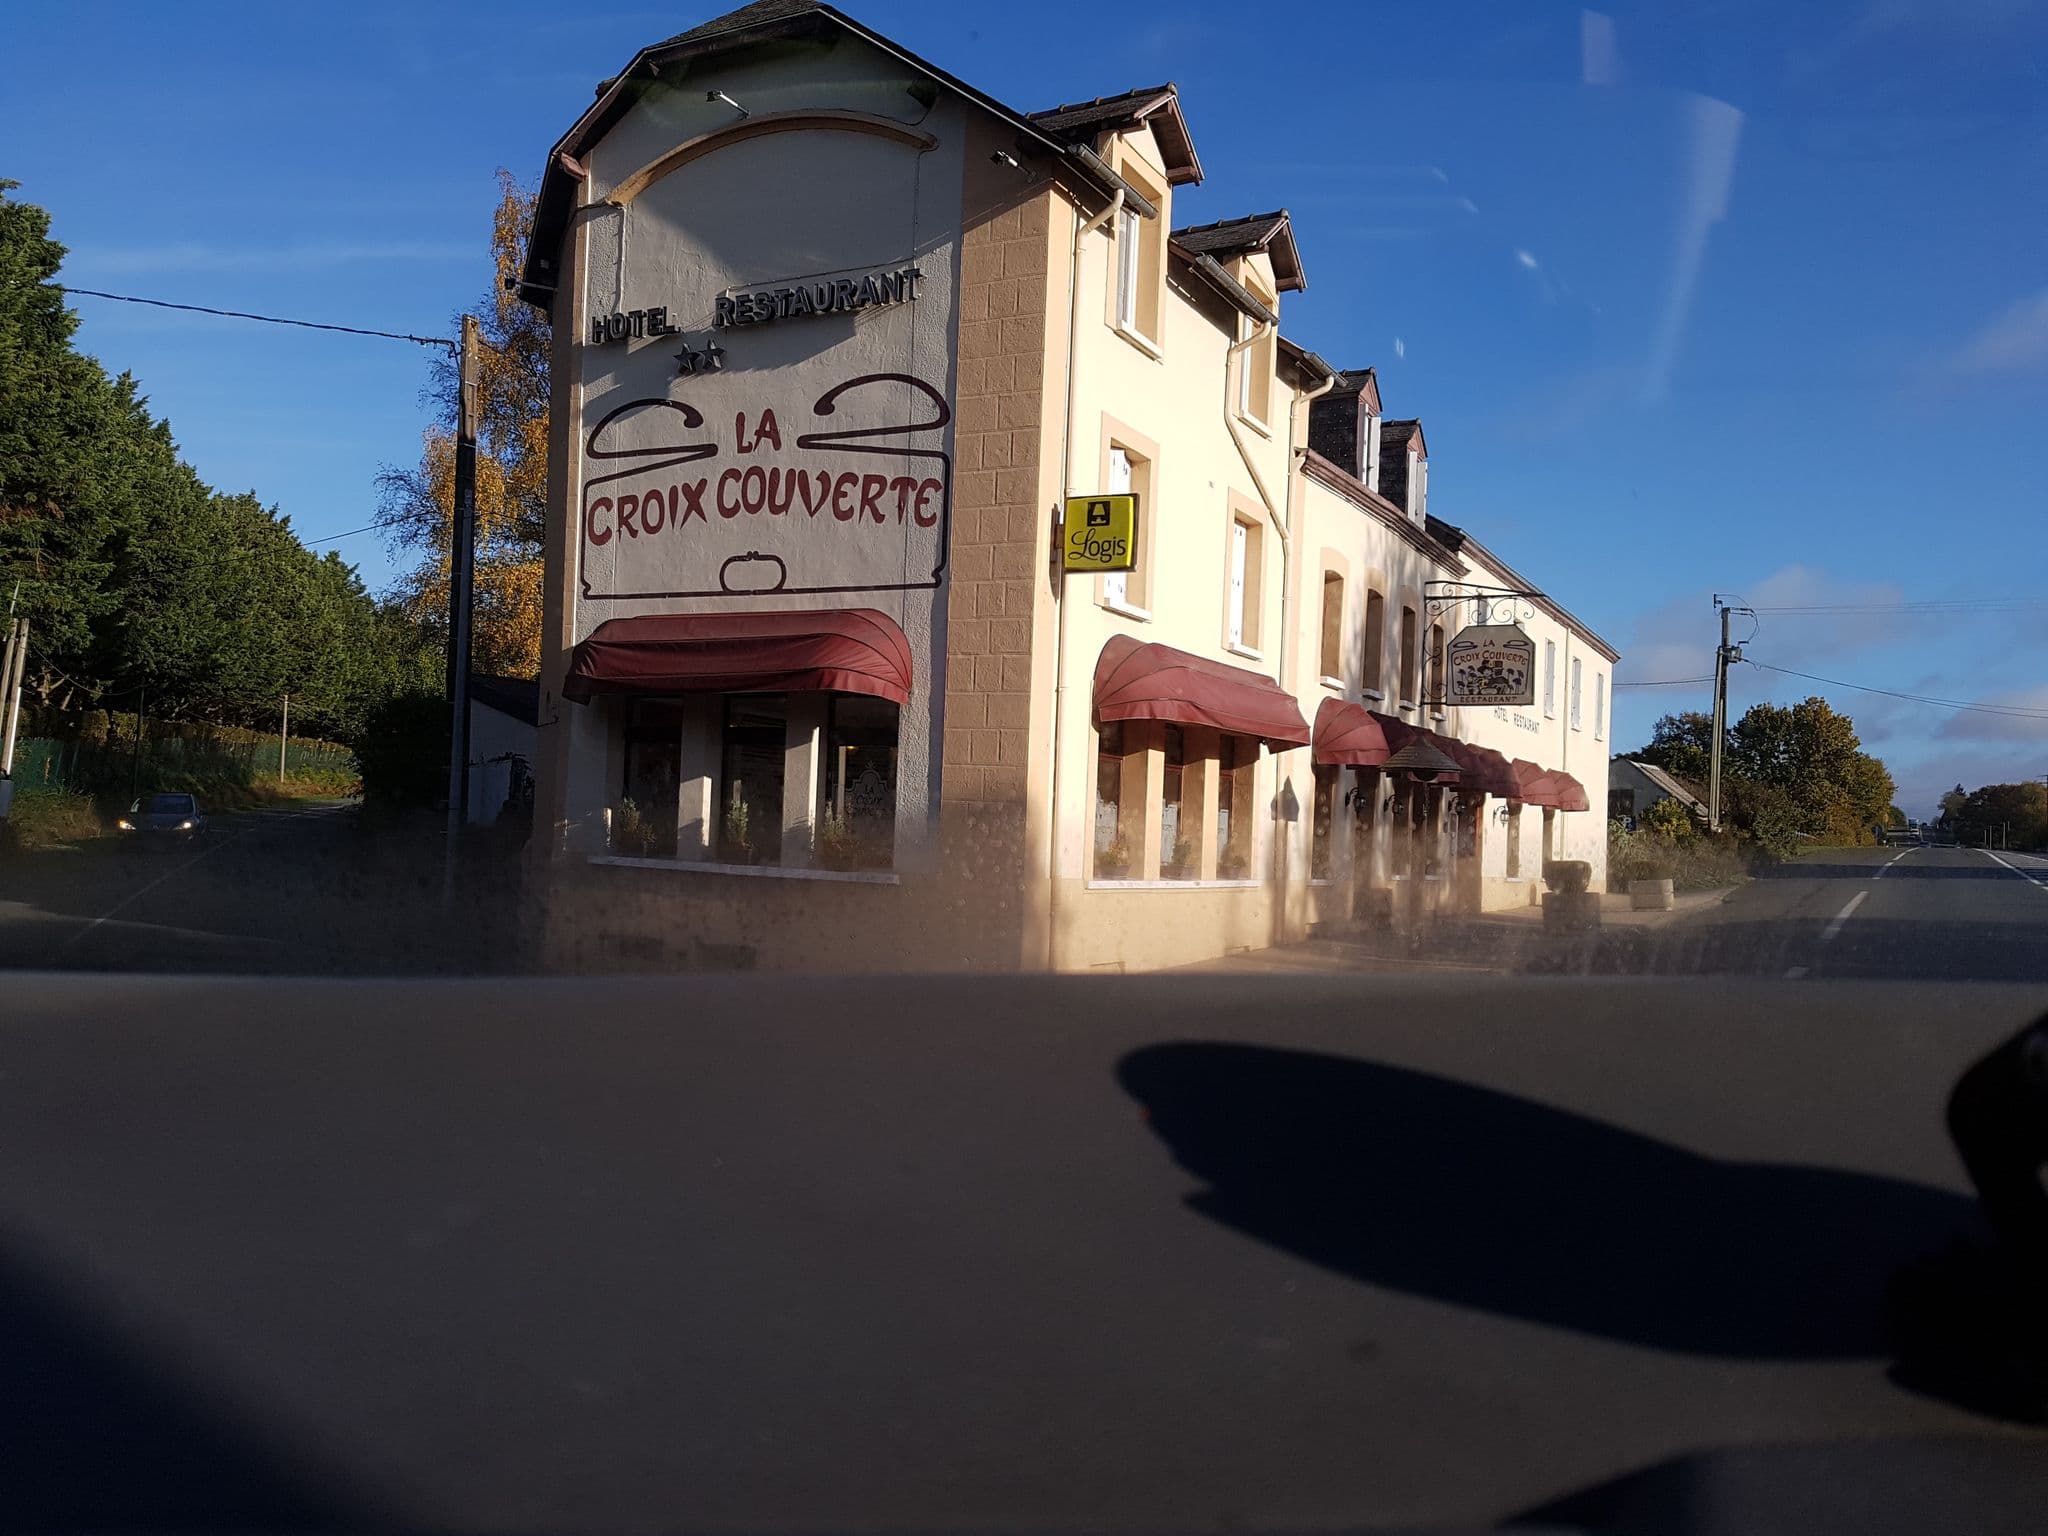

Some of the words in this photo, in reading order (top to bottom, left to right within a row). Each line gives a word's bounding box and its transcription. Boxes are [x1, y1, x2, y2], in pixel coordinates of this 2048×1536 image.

[591, 305, 681, 343] HOTEL
[714, 268, 922, 327] RESTAURANT
[735, 408, 781, 454] LA
[587, 478, 709, 546] CROIX
[717, 466, 942, 527] COUVERTE
[1068, 528, 1126, 563] Logis
[1454, 652, 1480, 666] CROIX
[1482, 650, 1528, 665] COUVERTE
[1513, 713, 1540, 734] RESTAURANT
